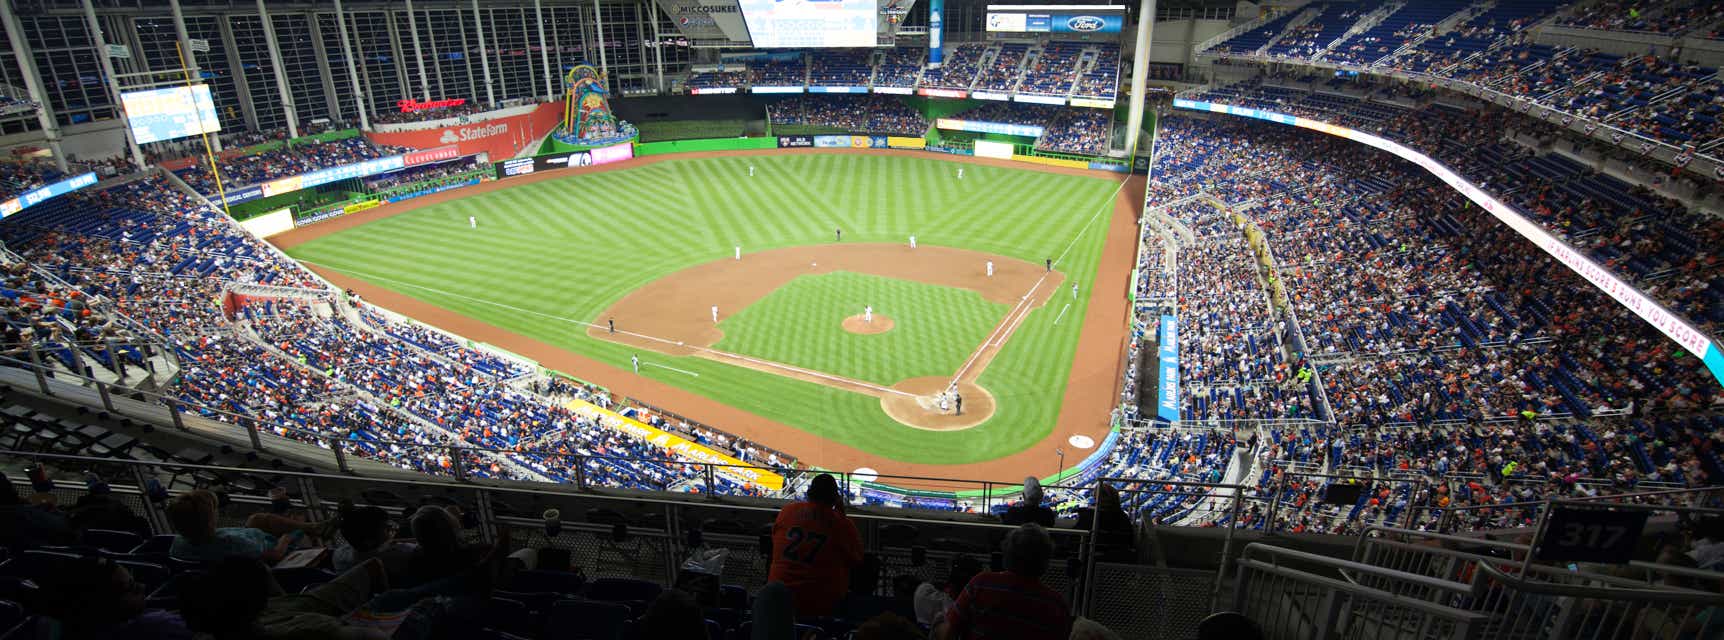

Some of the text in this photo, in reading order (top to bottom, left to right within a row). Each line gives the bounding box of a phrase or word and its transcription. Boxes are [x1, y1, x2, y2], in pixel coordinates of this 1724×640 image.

[680, 5, 737, 13] MICCOSUKEE
[1074, 18, 1098, 29] Ford
[1555, 245, 1585, 272] MARLINS
[1584, 265, 1611, 289] SCORE
[1610, 281, 1618, 294] 5
[1647, 304, 1668, 328] YOU
[1668, 320, 1706, 354] SCORE
[782, 525, 828, 564] 27
[1559, 521, 1626, 549] 317
